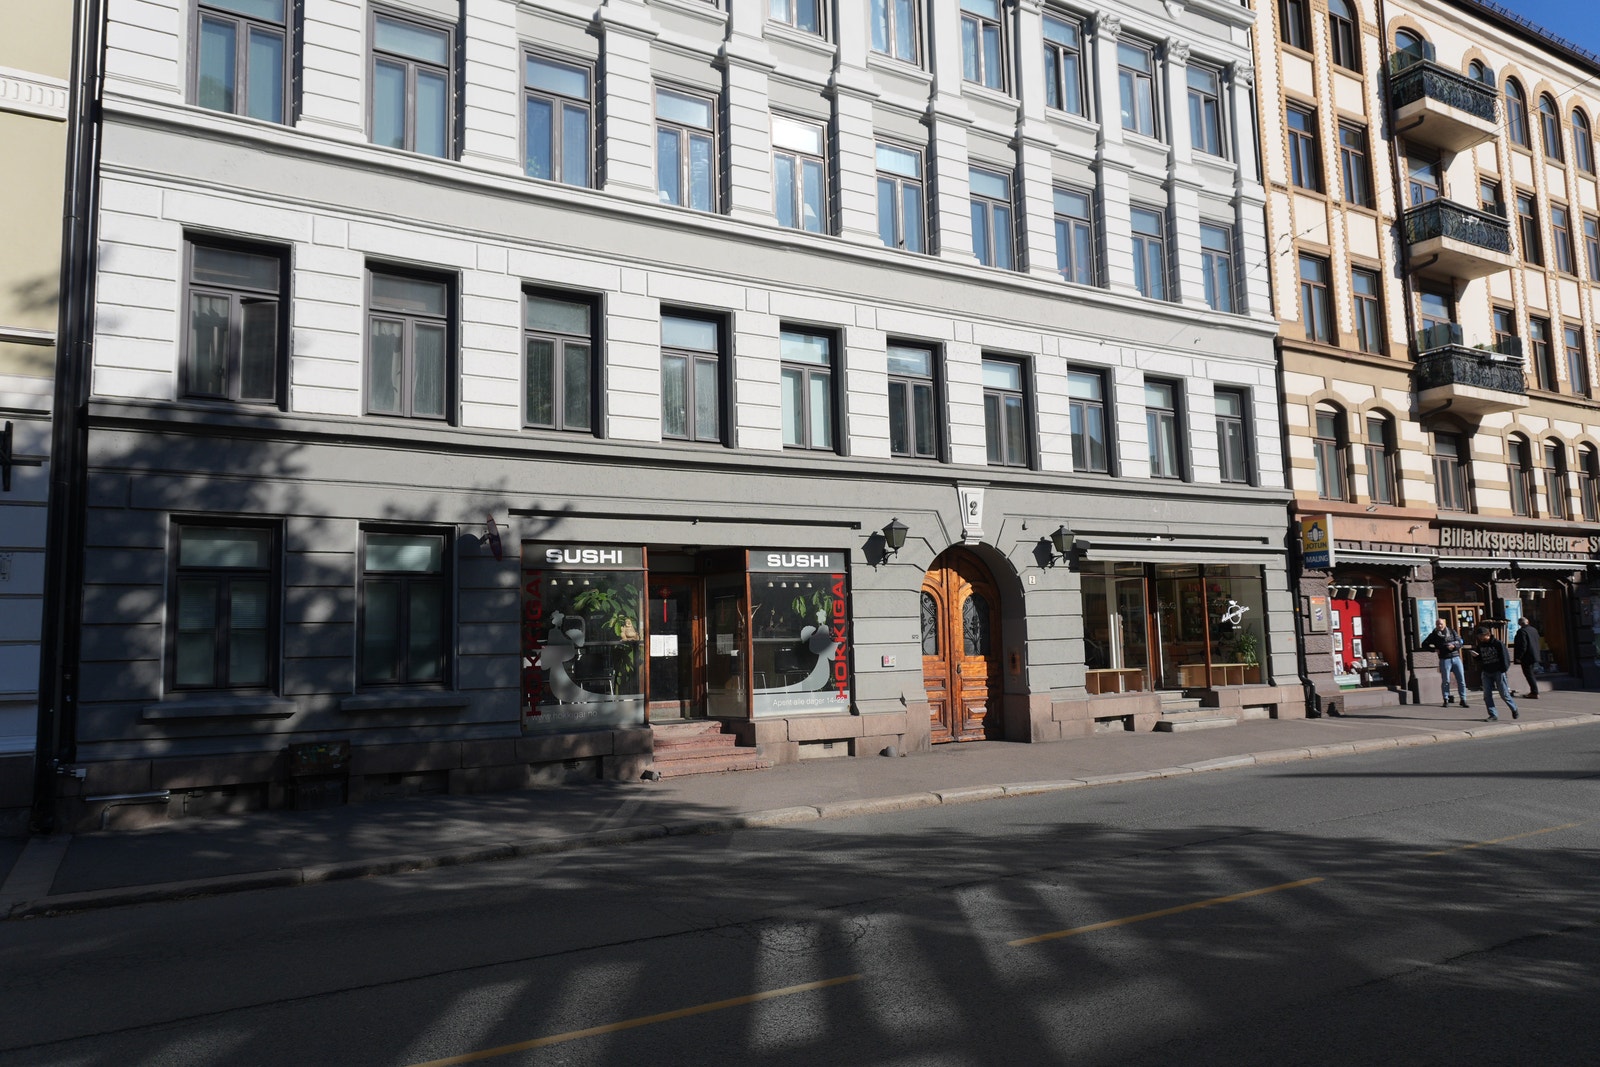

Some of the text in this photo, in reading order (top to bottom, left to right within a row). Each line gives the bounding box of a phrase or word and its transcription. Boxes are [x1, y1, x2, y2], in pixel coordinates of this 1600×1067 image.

[970, 501, 978, 516] 2
[1306, 541, 1328, 550] JOTUN
[1440, 527, 1570, 553] Billakkspesialisten
[545, 548, 623, 564] SUSHI
[767, 554, 829, 568] SUSHI
[1305, 554, 1329, 563] MALING
[526, 569, 543, 717] HOKKIGAI
[831, 573, 848, 700] HOKKIGAI
